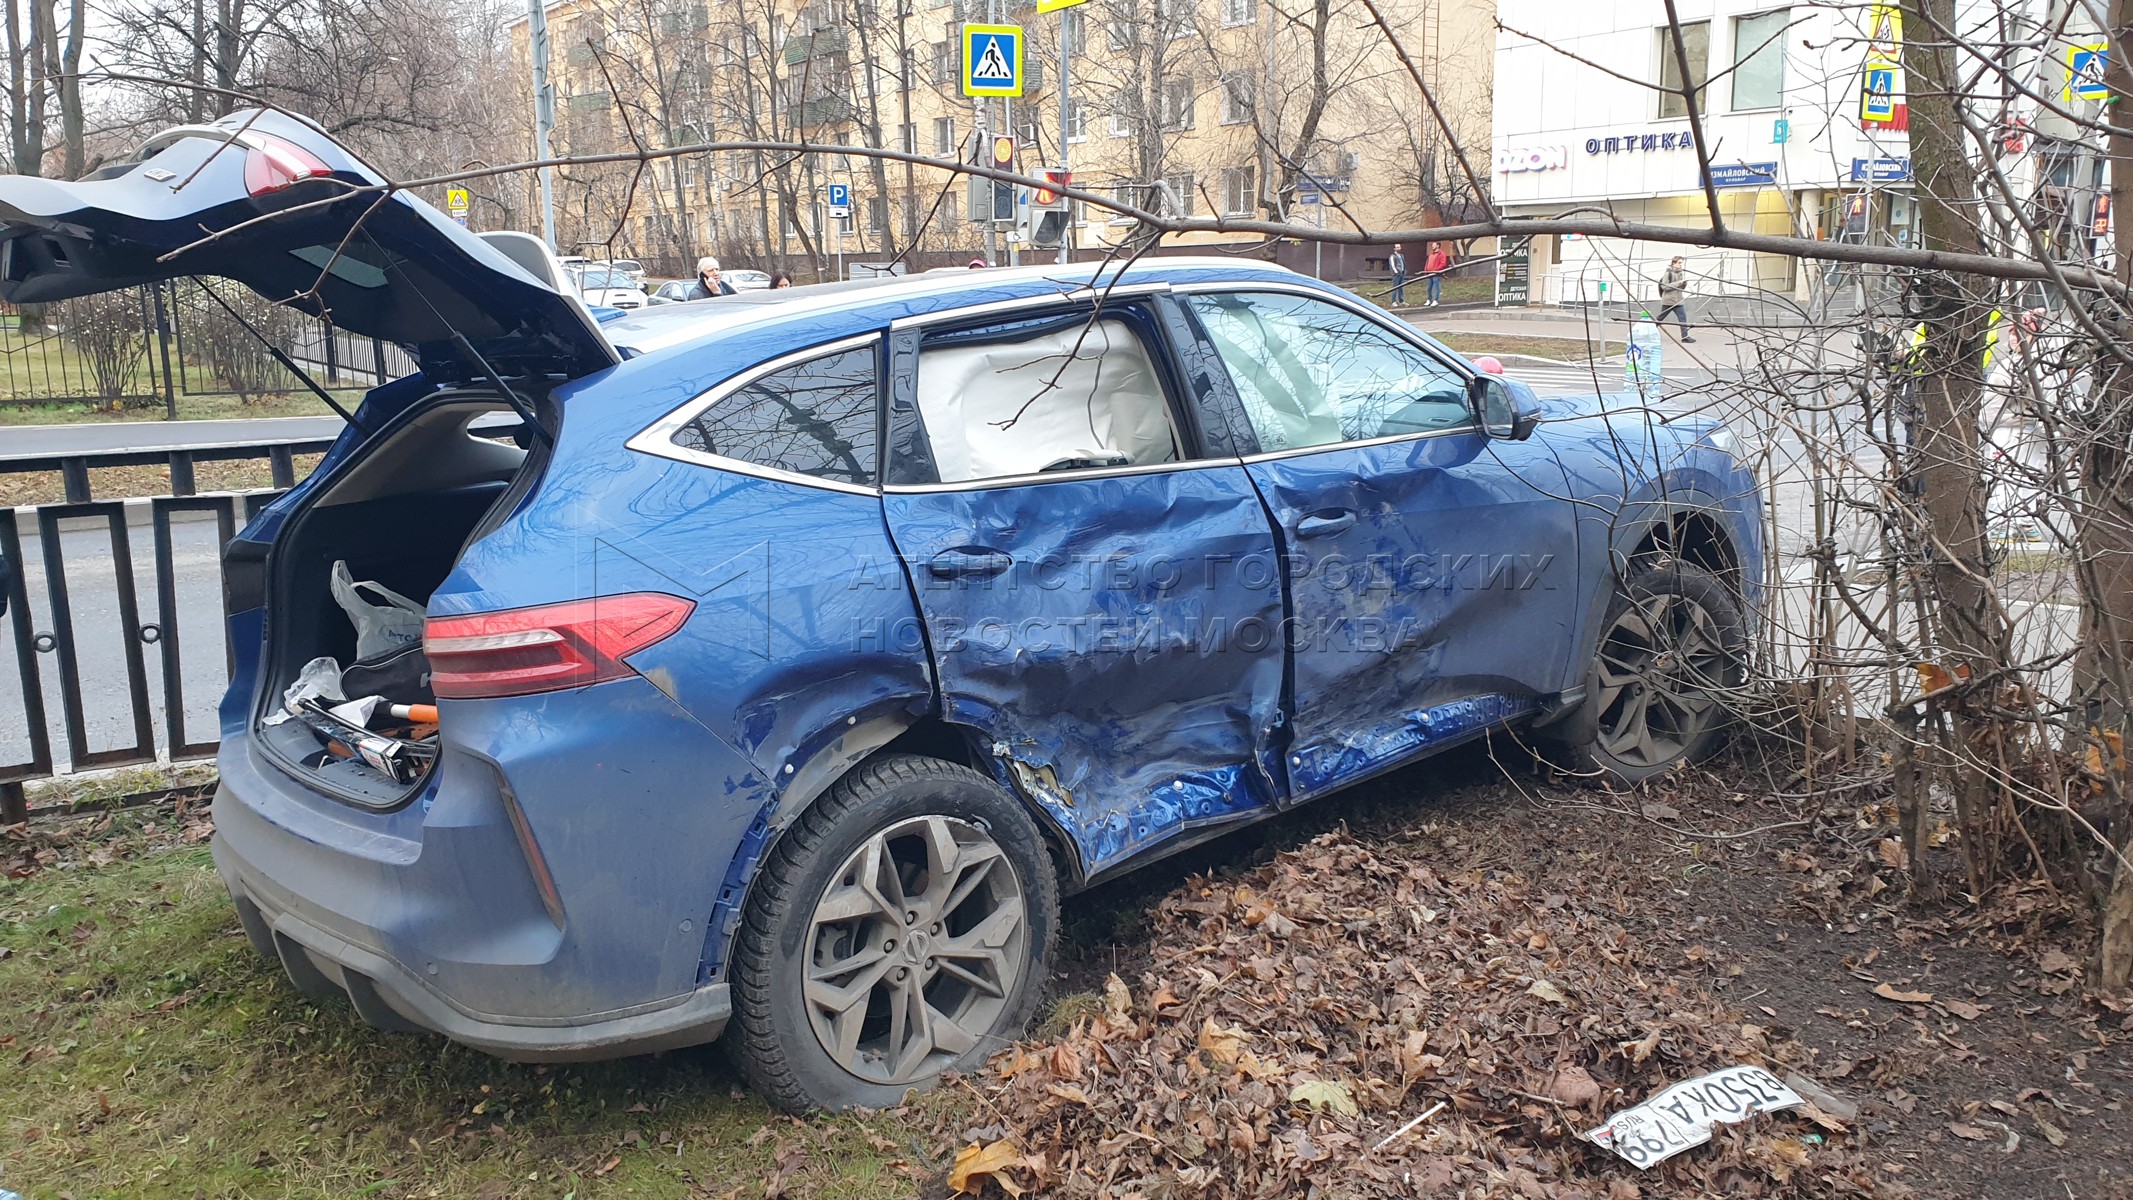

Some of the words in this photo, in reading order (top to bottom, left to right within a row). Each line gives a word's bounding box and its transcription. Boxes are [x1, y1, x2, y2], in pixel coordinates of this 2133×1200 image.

[1586, 131, 1695, 156] ОПТИКА
[833, 187, 844, 204] P
[1498, 292, 1526, 301] ОПТИКА
[1616, 1113, 1645, 1131] RUS
